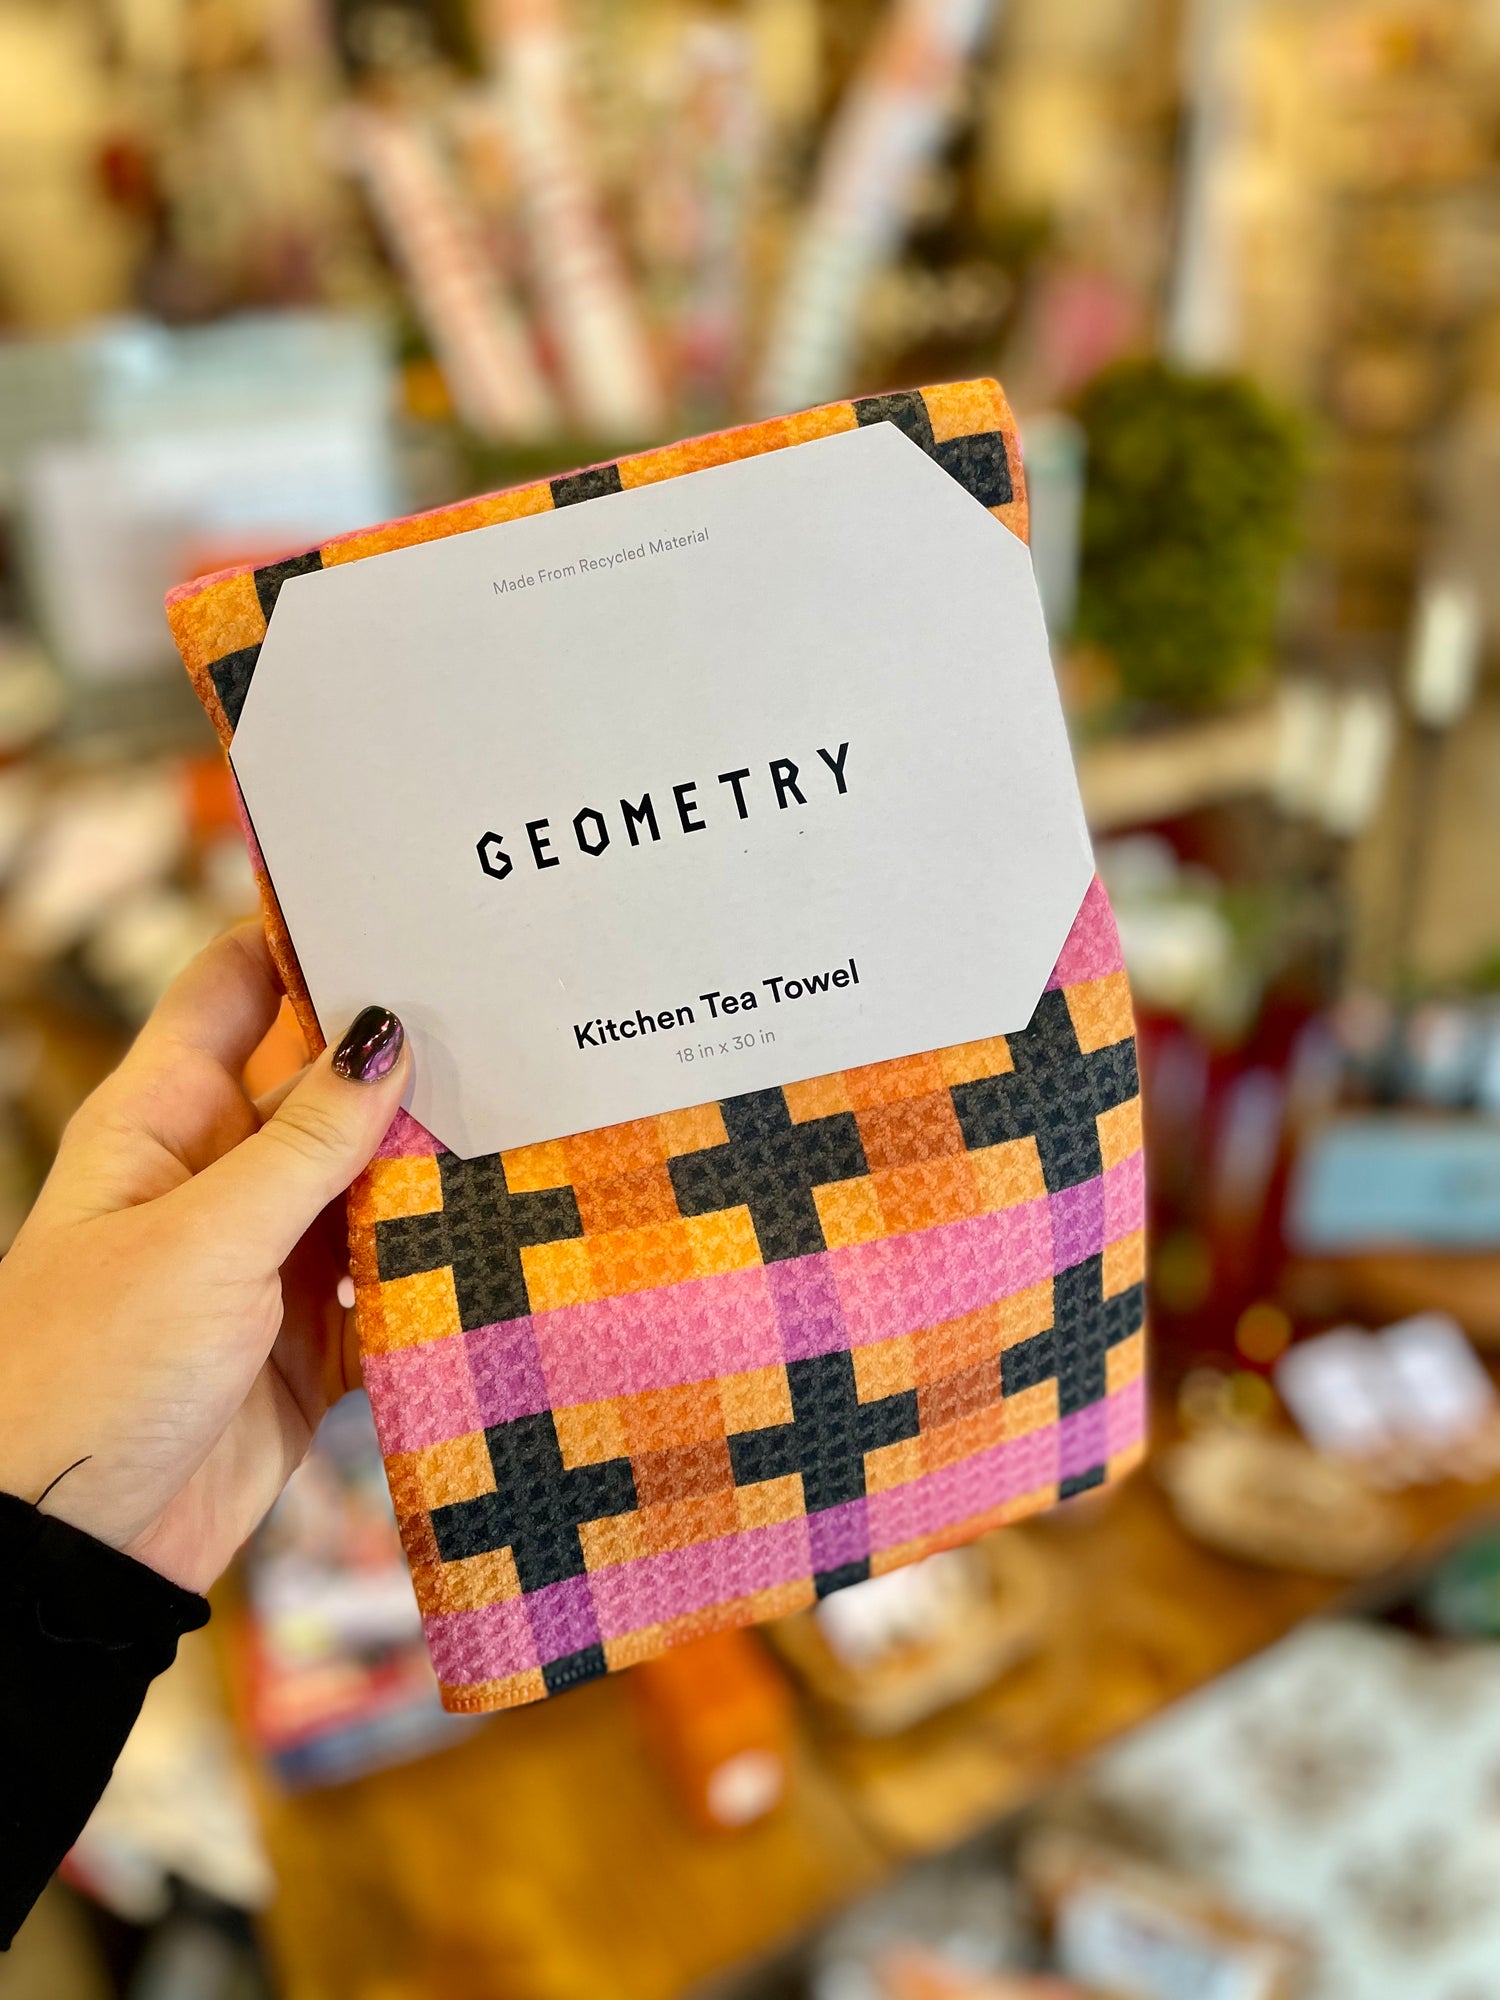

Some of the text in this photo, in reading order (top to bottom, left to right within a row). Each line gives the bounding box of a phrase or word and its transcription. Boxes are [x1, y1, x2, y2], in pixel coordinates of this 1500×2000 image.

[493, 527, 710, 595] Made From Recycled Material
[476, 742, 850, 880] GEOMETRY
[573, 957, 860, 1050] Kitchen Tea Towel
[675, 1028, 776, 1064] 18 in x 30 in
